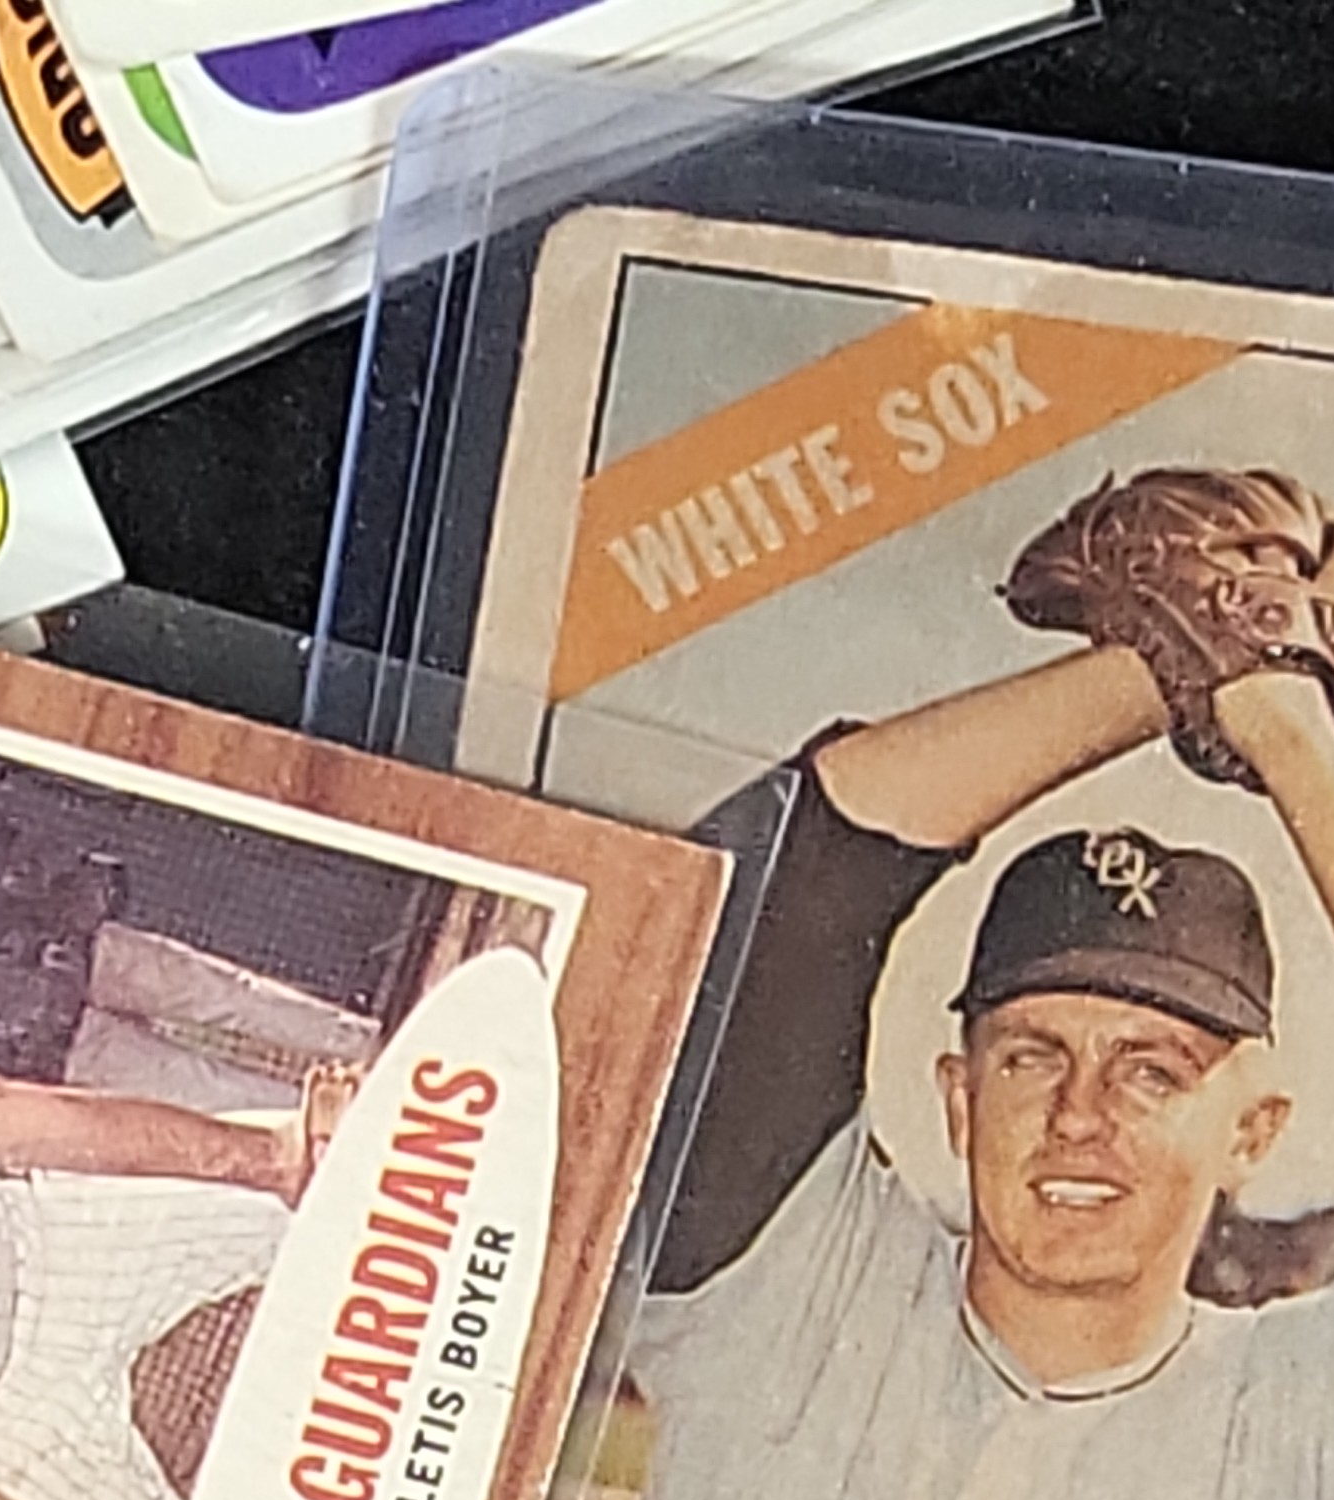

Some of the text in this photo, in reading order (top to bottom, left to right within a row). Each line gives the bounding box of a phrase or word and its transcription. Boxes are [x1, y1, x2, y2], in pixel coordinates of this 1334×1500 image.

[607, 331, 1052, 614] WHITE SOX
[440, 1223, 515, 1371] BOYER
